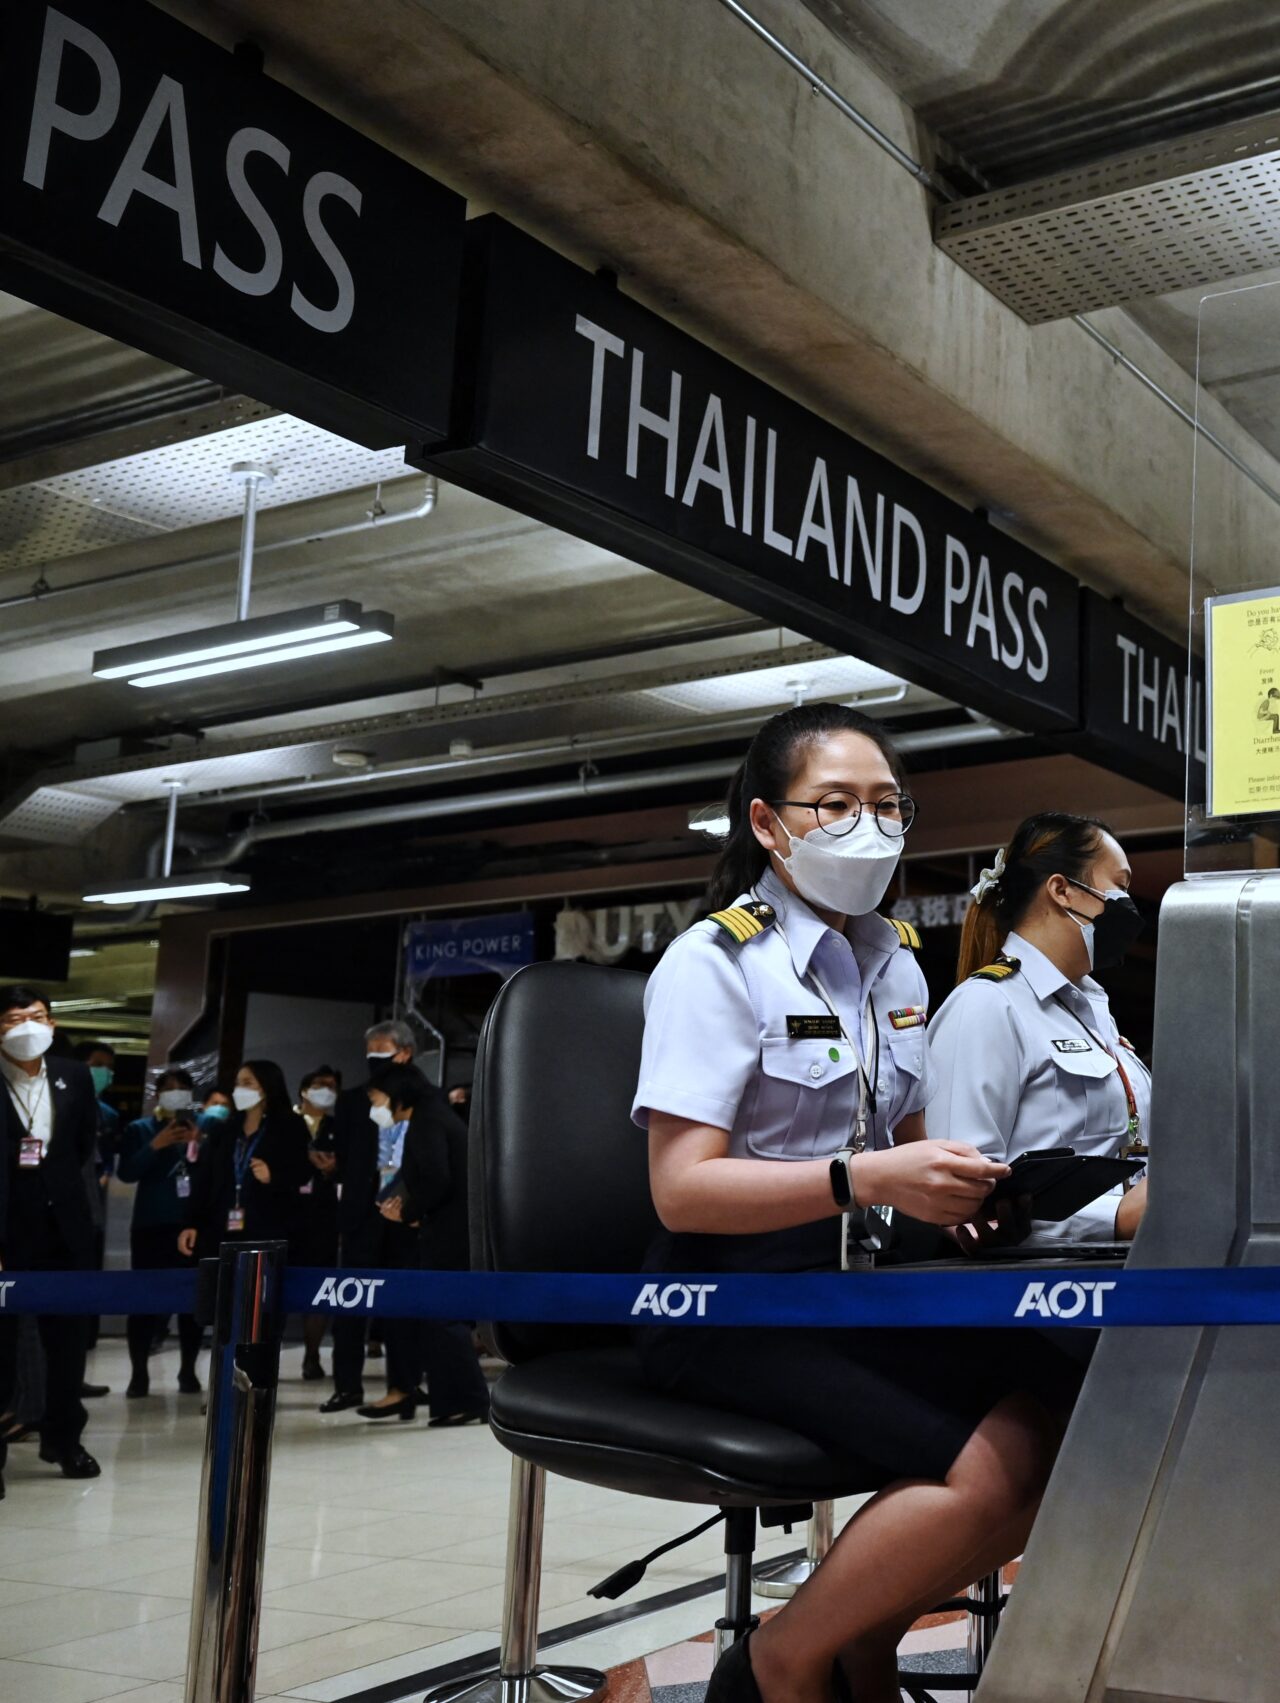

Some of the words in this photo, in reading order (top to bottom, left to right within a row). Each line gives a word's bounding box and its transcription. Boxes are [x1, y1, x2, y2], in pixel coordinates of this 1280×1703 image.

[23, 5, 363, 333] PASS
[575, 313, 928, 616] THAILAND
[944, 533, 1049, 683] PASS
[1117, 634, 1207, 764] THAIL
[415, 939, 456, 961] KING
[462, 935, 522, 956] POWER
[311, 1277, 385, 1308] AOT
[631, 1282, 718, 1318] AOT
[1014, 1281, 1116, 1319] AOT
